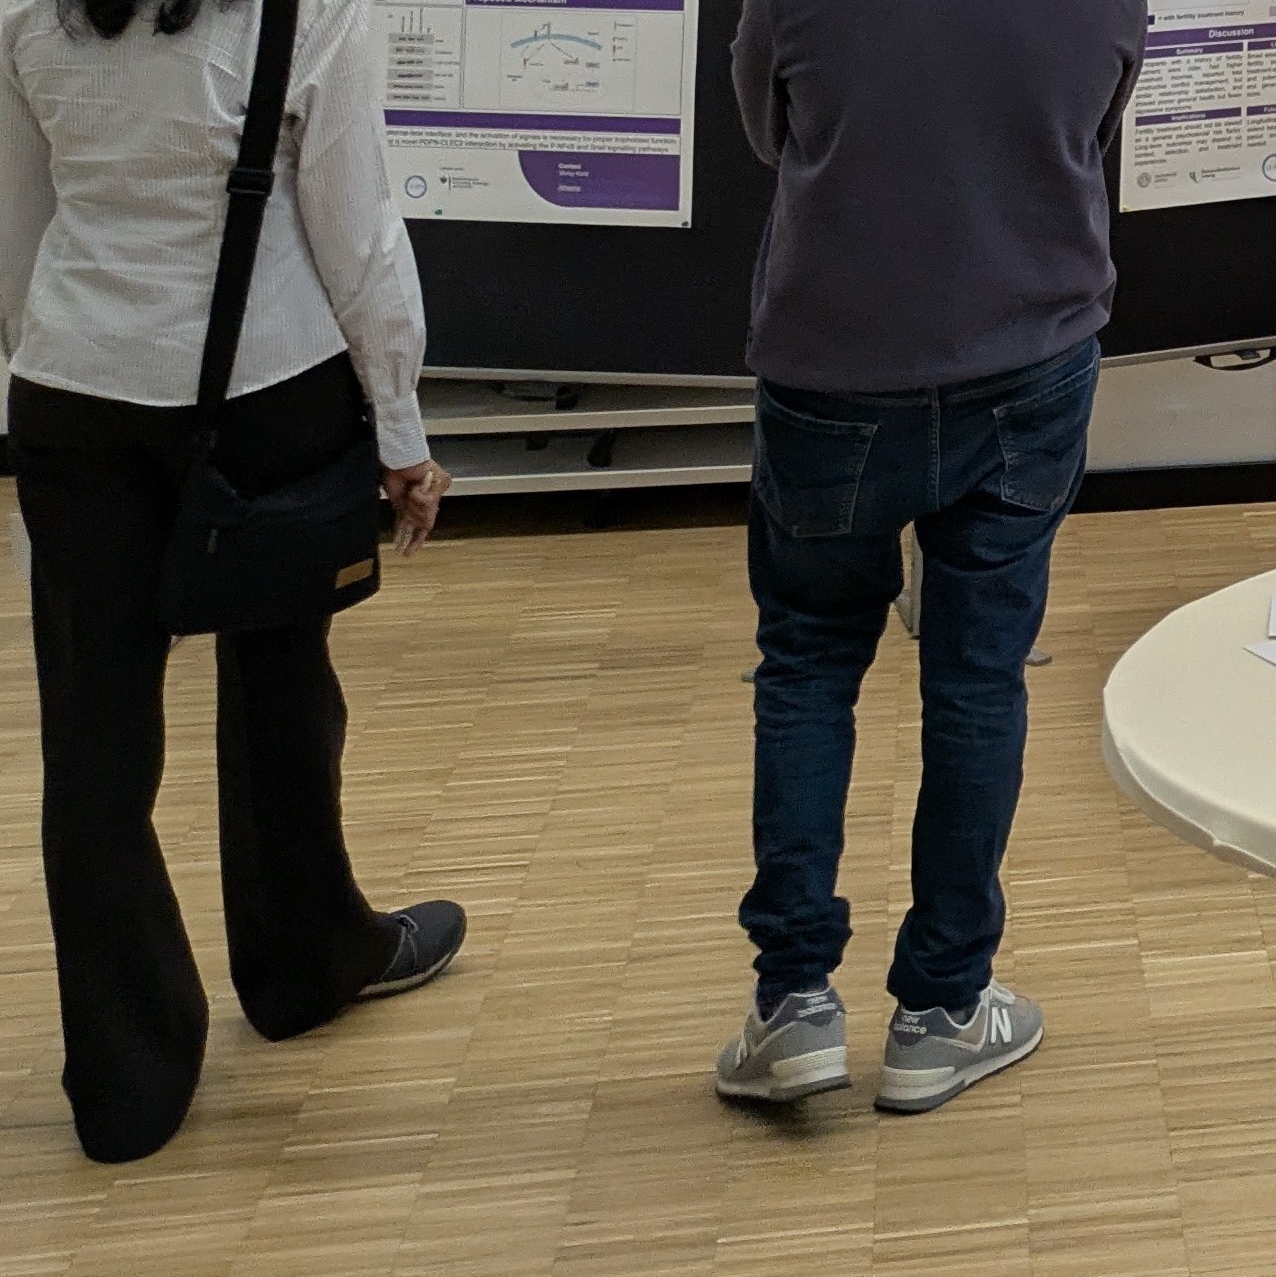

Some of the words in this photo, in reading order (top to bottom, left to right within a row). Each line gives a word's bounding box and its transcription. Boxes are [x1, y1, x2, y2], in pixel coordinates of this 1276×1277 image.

[1208, 27, 1254, 38] Discussion
[1176, 47, 1204, 55] Summary
[901, 1014, 920, 1025] new
[990, 1007, 1013, 1044] N
